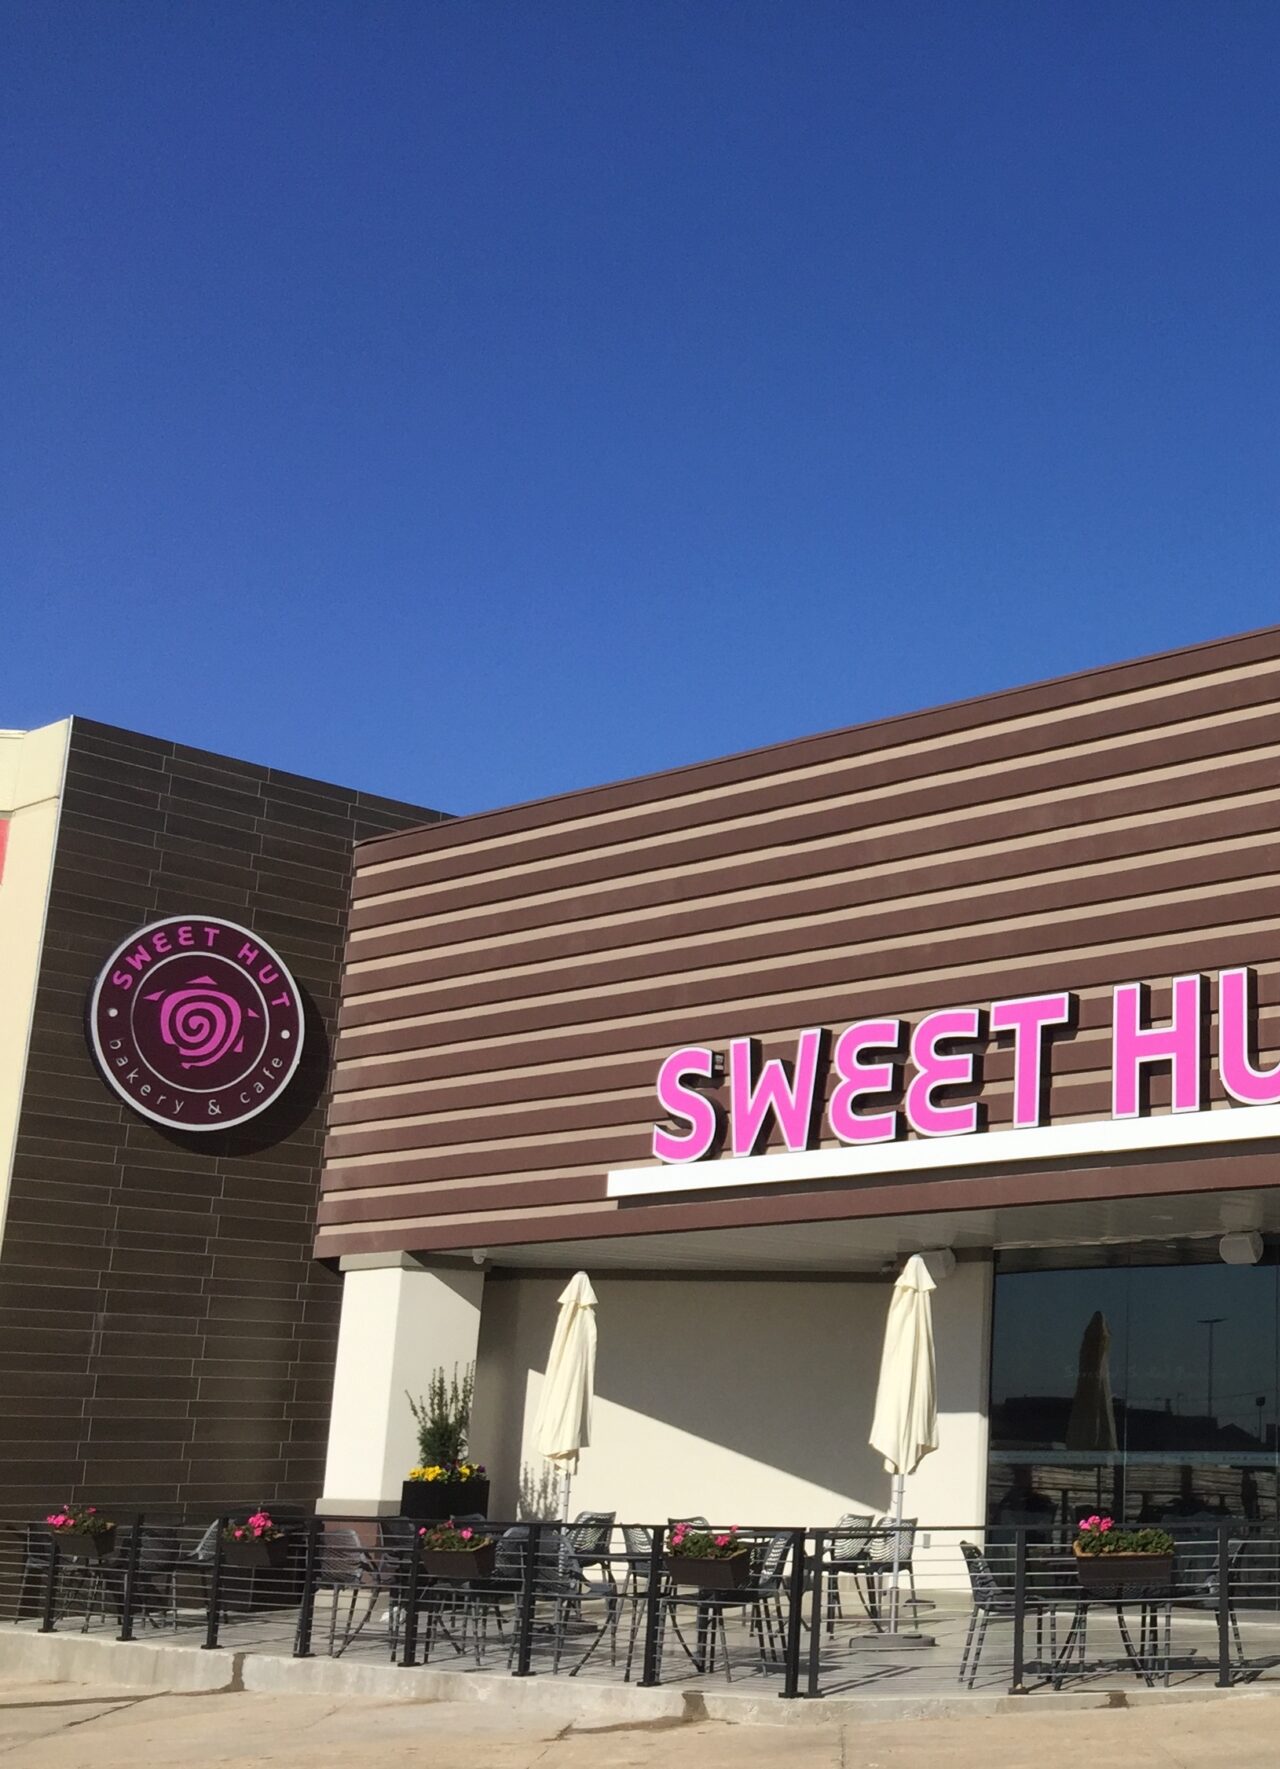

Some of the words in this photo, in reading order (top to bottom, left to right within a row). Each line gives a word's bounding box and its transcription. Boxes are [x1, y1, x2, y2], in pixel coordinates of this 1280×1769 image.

[112, 925, 220, 991] SWEET
[236, 942, 290, 1008] HUT
[109, 1037, 184, 1115] bakery
[207, 1099, 222, 1115] &
[239, 1056, 283, 1104] cafe
[652, 991, 1070, 1164] SWEET
